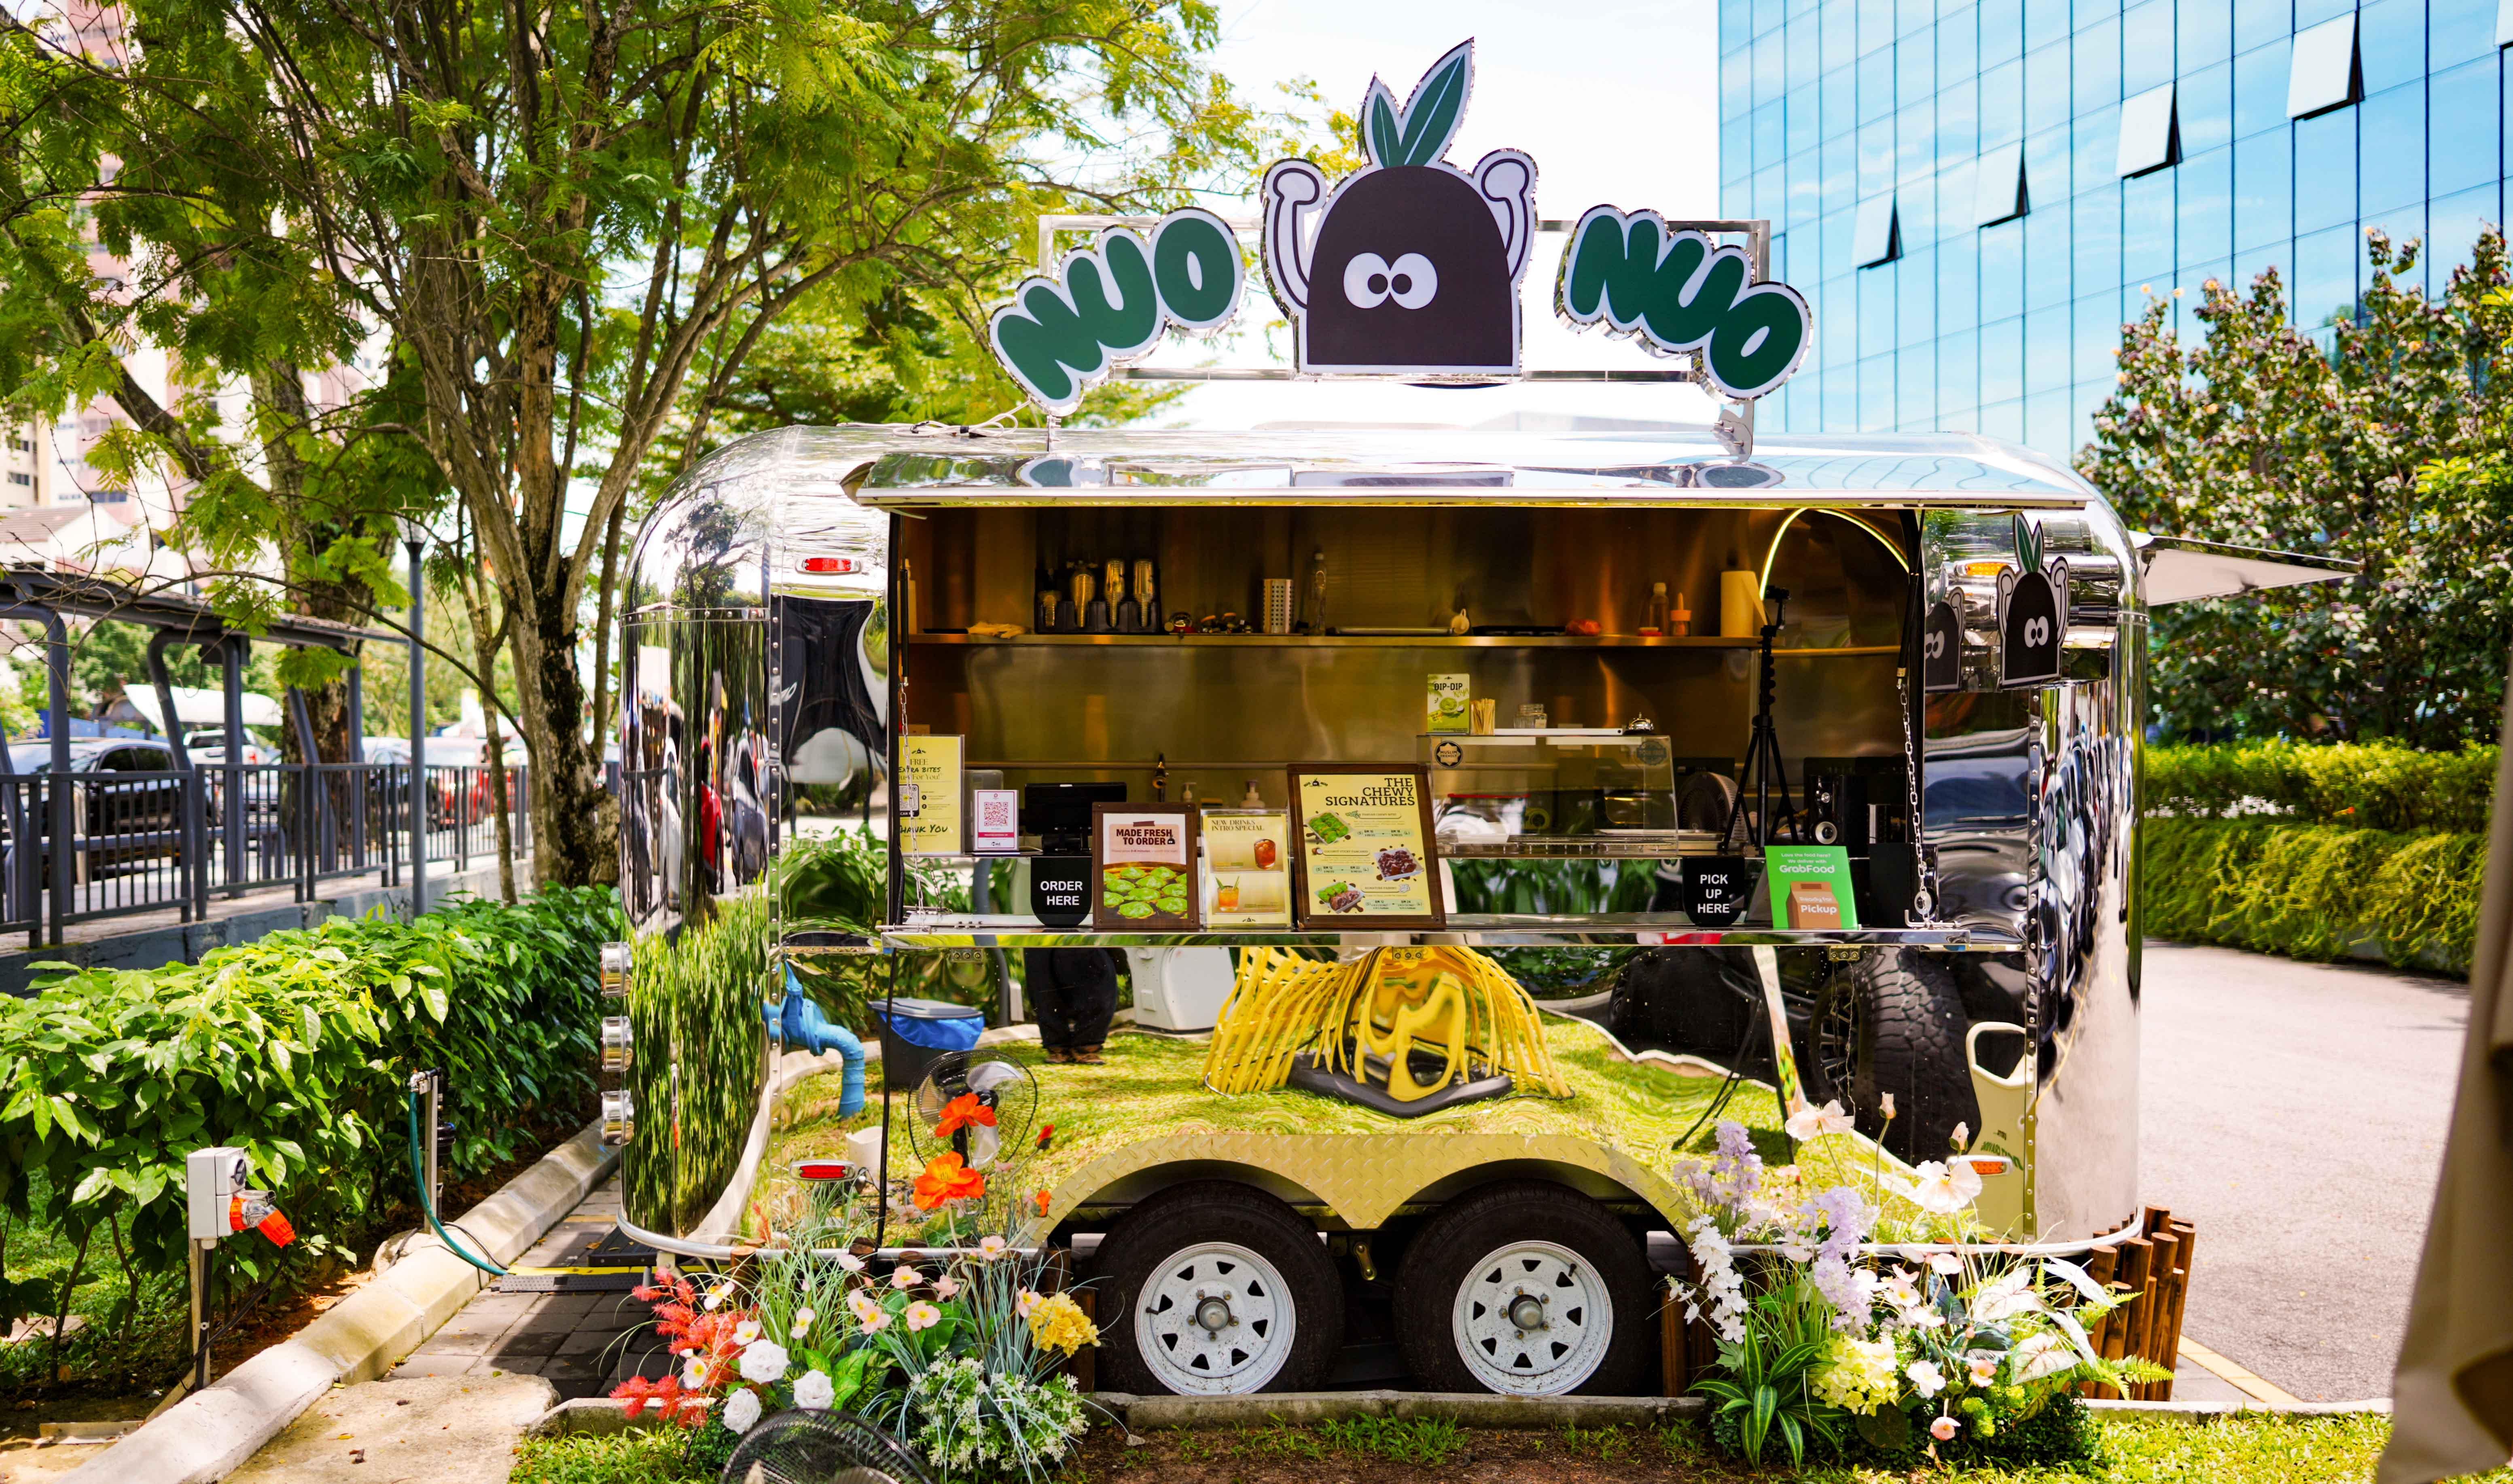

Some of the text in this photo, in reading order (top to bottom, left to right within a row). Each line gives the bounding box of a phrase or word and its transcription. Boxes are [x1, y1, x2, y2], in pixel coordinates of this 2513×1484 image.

[1570, 214, 1804, 389] NUO
[996, 217, 1236, 400] NUO
[1384, 778, 1413, 787] THE
[1362, 787, 1413, 796] CHEWY
[1325, 796, 1415, 806] SIGNATURES
[930, 824, 948, 833] YOU
[1116, 829, 1172, 837] MADE FRESH
[1779, 864, 1835, 873] GrabFood
[1700, 874, 1728, 884] PICK
[1040, 881, 1083, 891] ORDER
[1705, 889, 1722, 899] UP
[1047, 895, 1080, 906] HERE
[1697, 903, 1730, 914] HERE
[1801, 904, 1837, 915] Pickup
